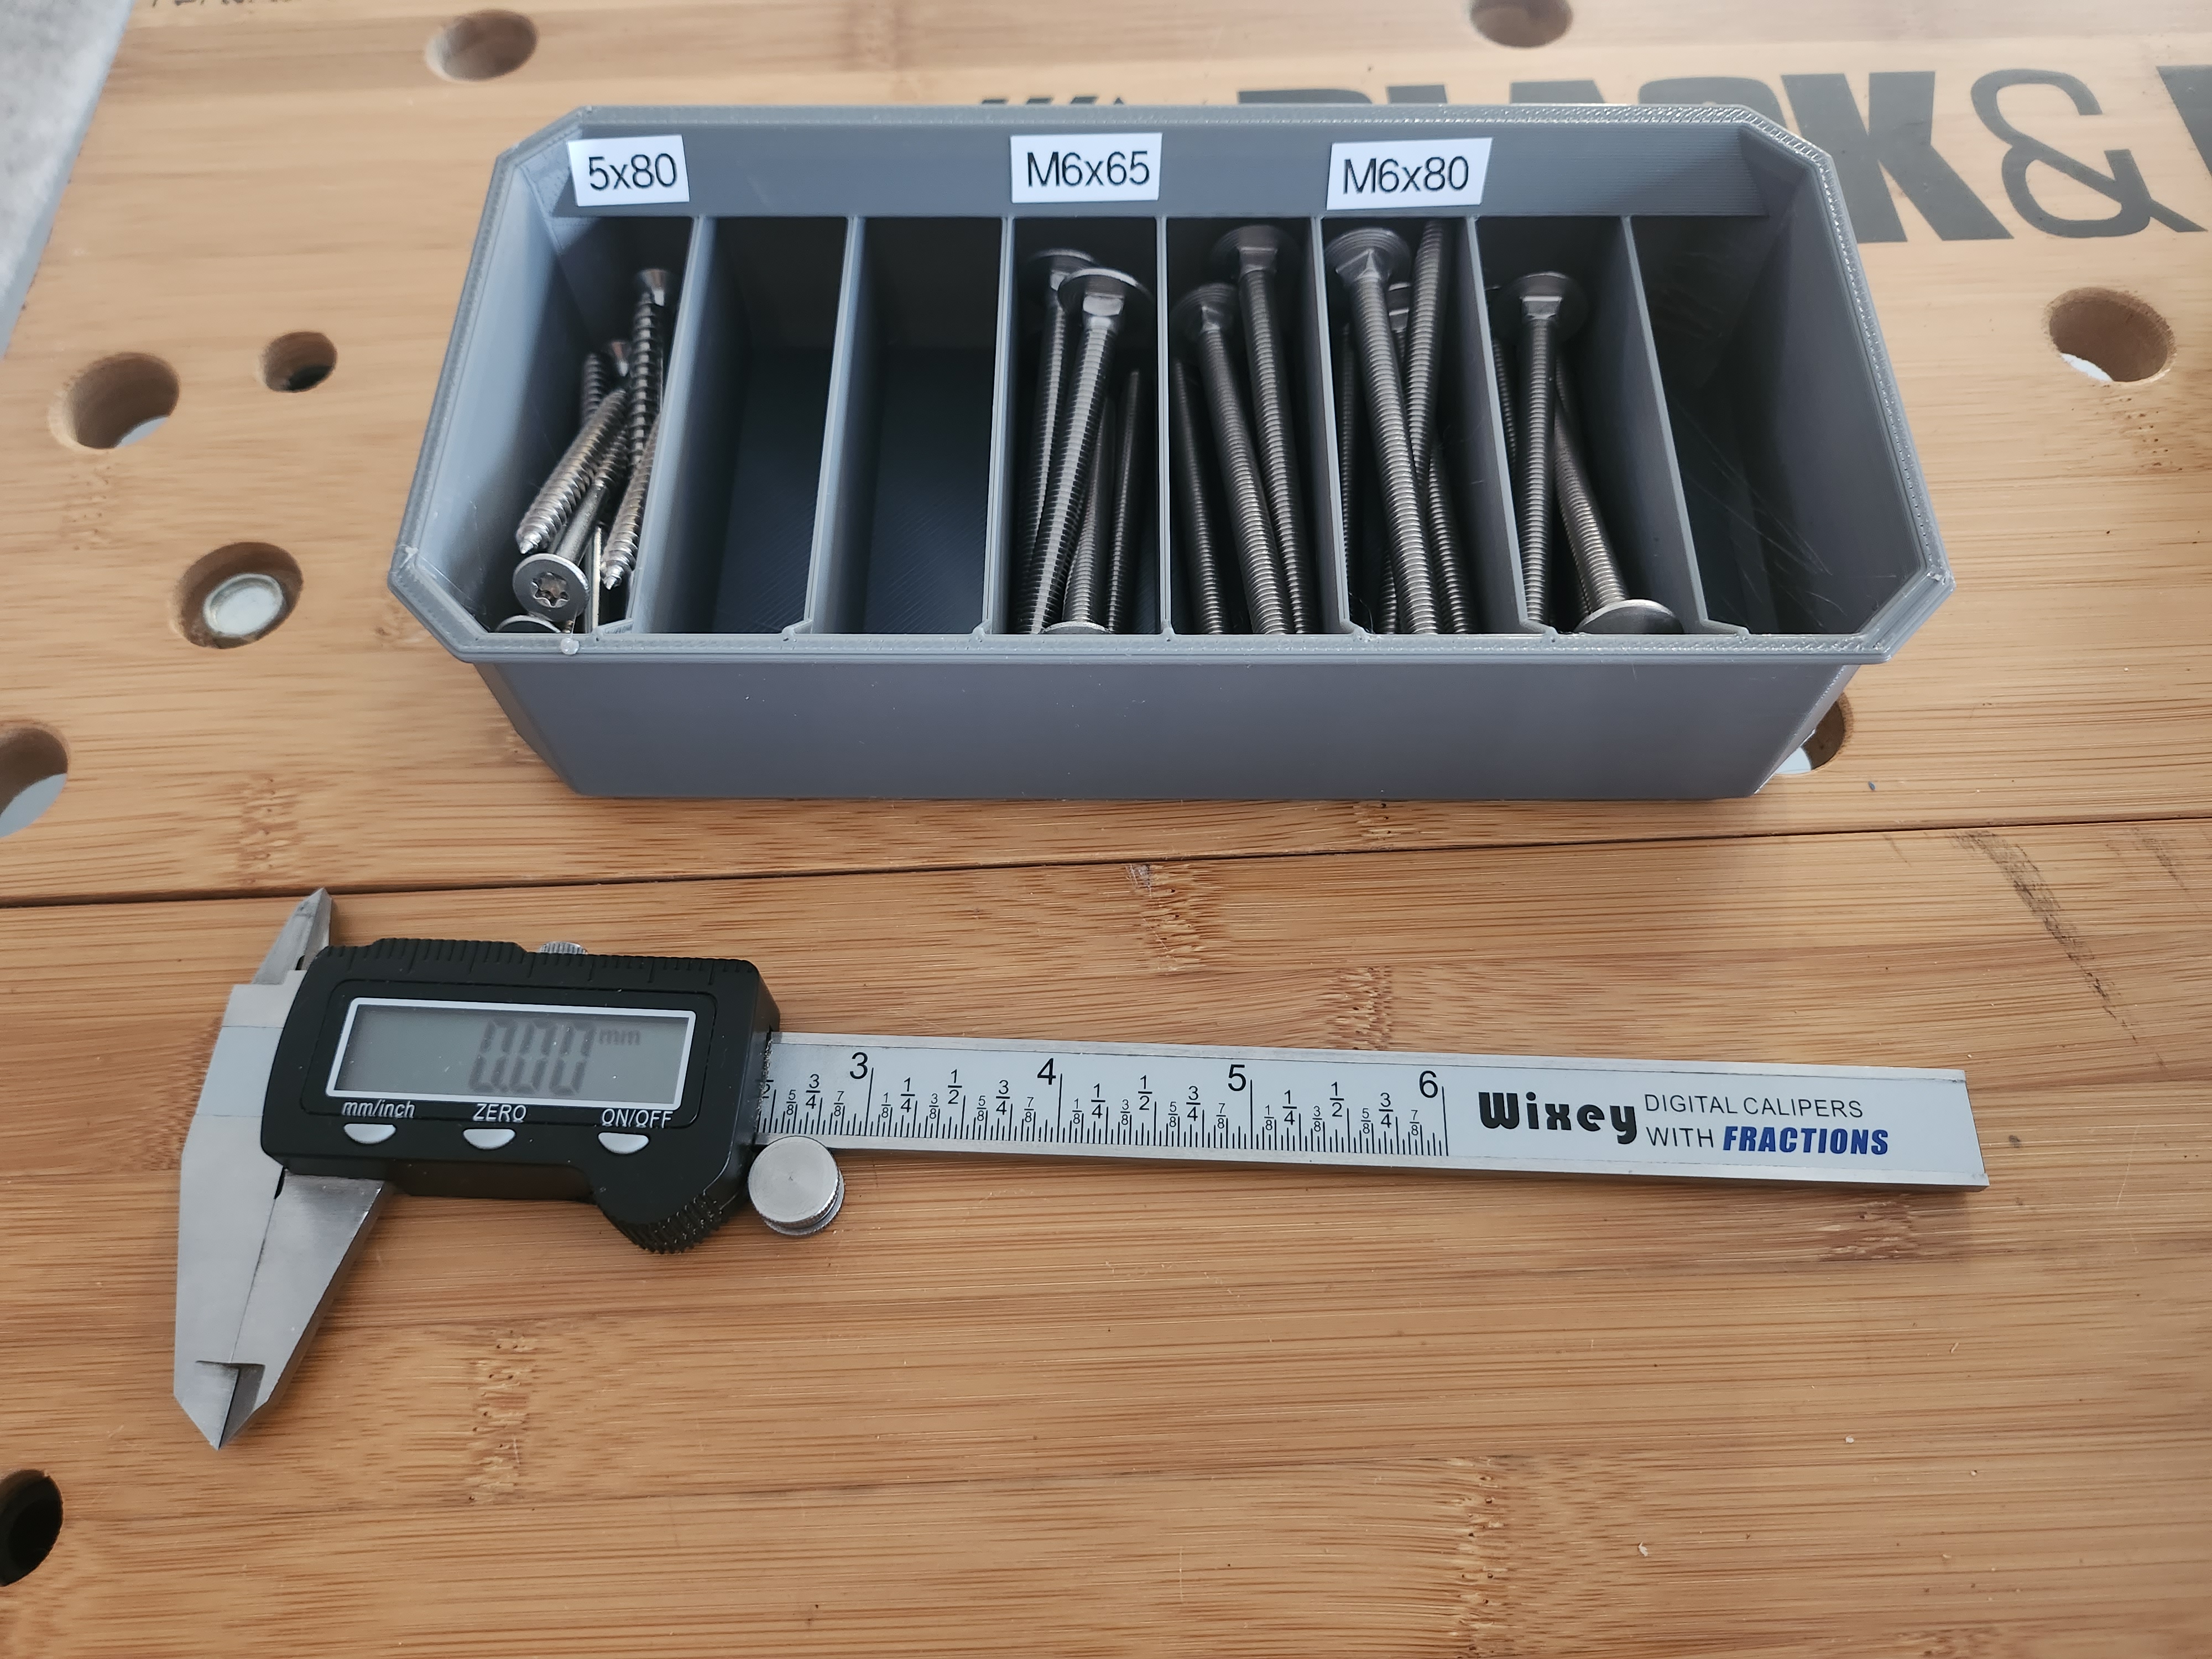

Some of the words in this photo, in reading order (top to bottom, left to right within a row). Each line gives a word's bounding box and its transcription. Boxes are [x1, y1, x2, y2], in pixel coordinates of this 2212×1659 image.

[588, 153, 678, 191] 5x80
[1027, 150, 1151, 188] M6x65
[1343, 156, 1470, 195] M6x80
[849, 1051, 868, 1079] 3
[1037, 1057, 1057, 1086] 4
[1228, 1063, 1246, 1092] 5
[1419, 1070, 1438, 1098] 6
[342, 1100, 415, 1119] mm/inch
[473, 1104, 526, 1122] ZERO
[602, 1108, 674, 1129] ON/OFF
[1478, 1092, 1638, 1145] Wixey
[1645, 1094, 1738, 1115] DIGITAL
[1743, 1097, 1864, 1119] CALIPERS
[1646, 1126, 1714, 1149] WITH
[1723, 1125, 1889, 1156] FRACTIONS
